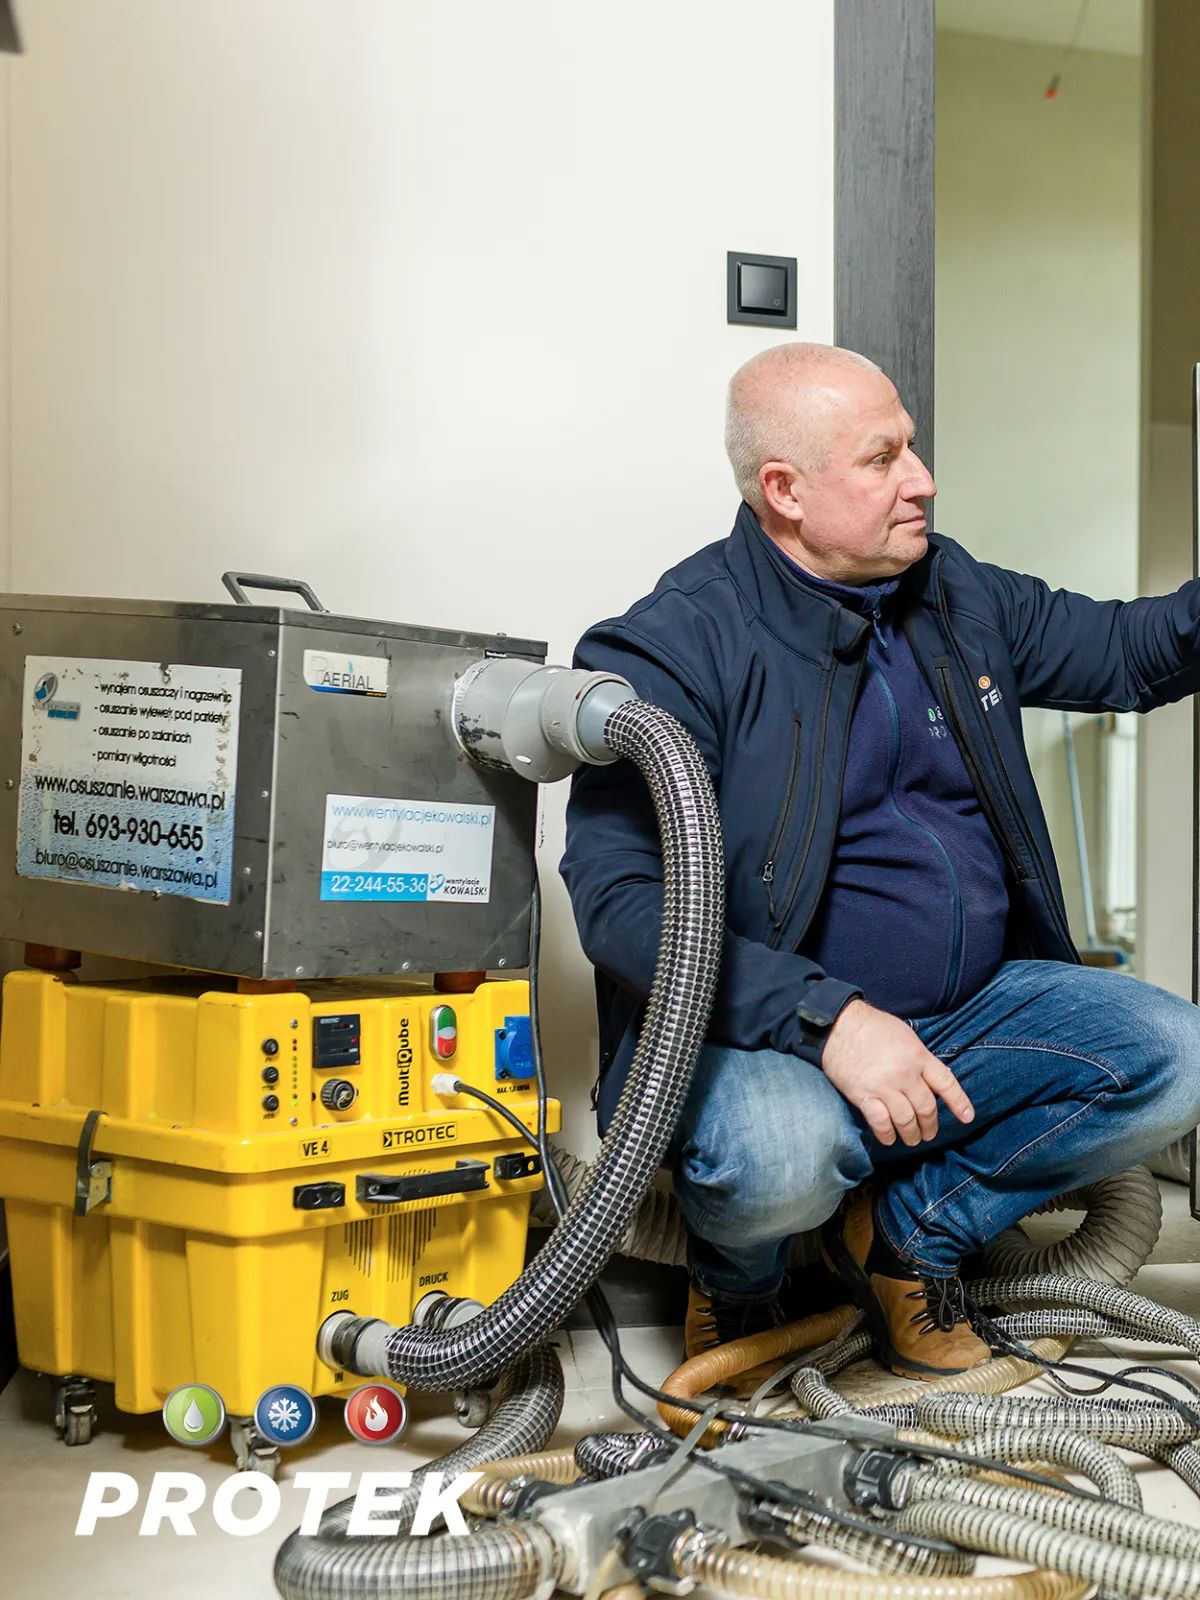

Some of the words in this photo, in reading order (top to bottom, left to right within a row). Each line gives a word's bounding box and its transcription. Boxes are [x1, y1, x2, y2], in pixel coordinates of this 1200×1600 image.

[322, 671, 374, 691] AERIAL
[100, 684, 136, 697] wynajem
[138, 687, 179, 701] osuszaczy
[99, 703, 137, 717] osuszanie
[174, 709, 192, 722] pod
[98, 725, 137, 739] osuszanie
[138, 730, 150, 741] po
[151, 730, 192, 745] zalaniach
[97, 750, 131, 765] pomiary
[35, 776, 225, 811] www.osuszanie.warszawa.pl
[332, 805, 491, 828] www.wentylacjekowalski.pl
[53, 809, 79, 836] tel.
[86, 813, 203, 852] 693-930-655
[327, 839, 444, 854] biuro@wentylacjekowalski.pl
[36, 848, 218, 890] biuro@osuszanie.warszawa.pl
[331, 874, 427, 894] 22-244-55-36
[446, 877, 480, 887] wentylacje
[394, 1124, 455, 1145] TROTEC
[303, 1142, 318, 1157] VE
[321, 1140, 328, 1154] 4
[419, 1272, 449, 1287] DRUCK
[331, 1290, 349, 1302] ZUG
[334, 1372, 344, 1384] IN
